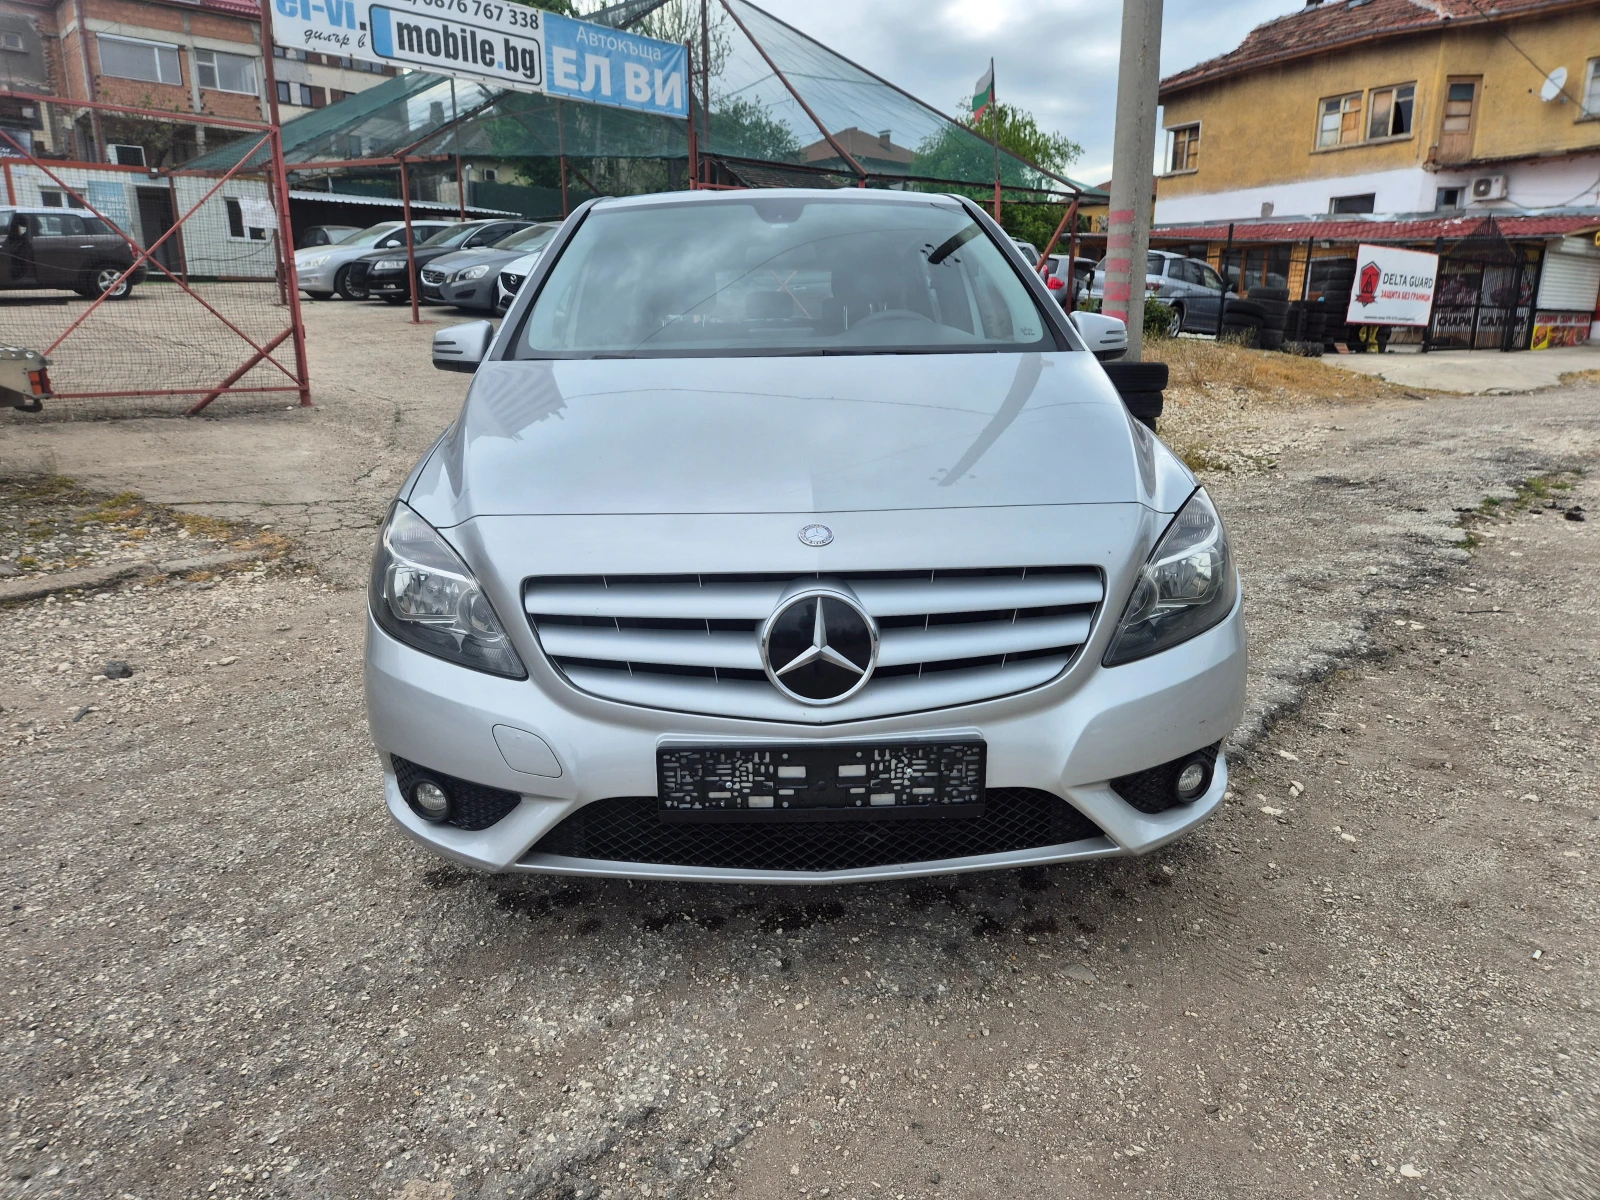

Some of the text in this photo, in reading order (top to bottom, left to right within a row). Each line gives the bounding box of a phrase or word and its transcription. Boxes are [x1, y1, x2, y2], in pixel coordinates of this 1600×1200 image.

[471, 0, 504, 22] 767
[508, 9, 540, 30] 338
[304, 29, 367, 48] дилър в
[396, 21, 536, 80] mobile.bg
[576, 25, 662, 62] Автокъща
[552, 45, 683, 110] ЕЛ ВИ
[1382, 272, 1434, 289] DELTA GUARD
